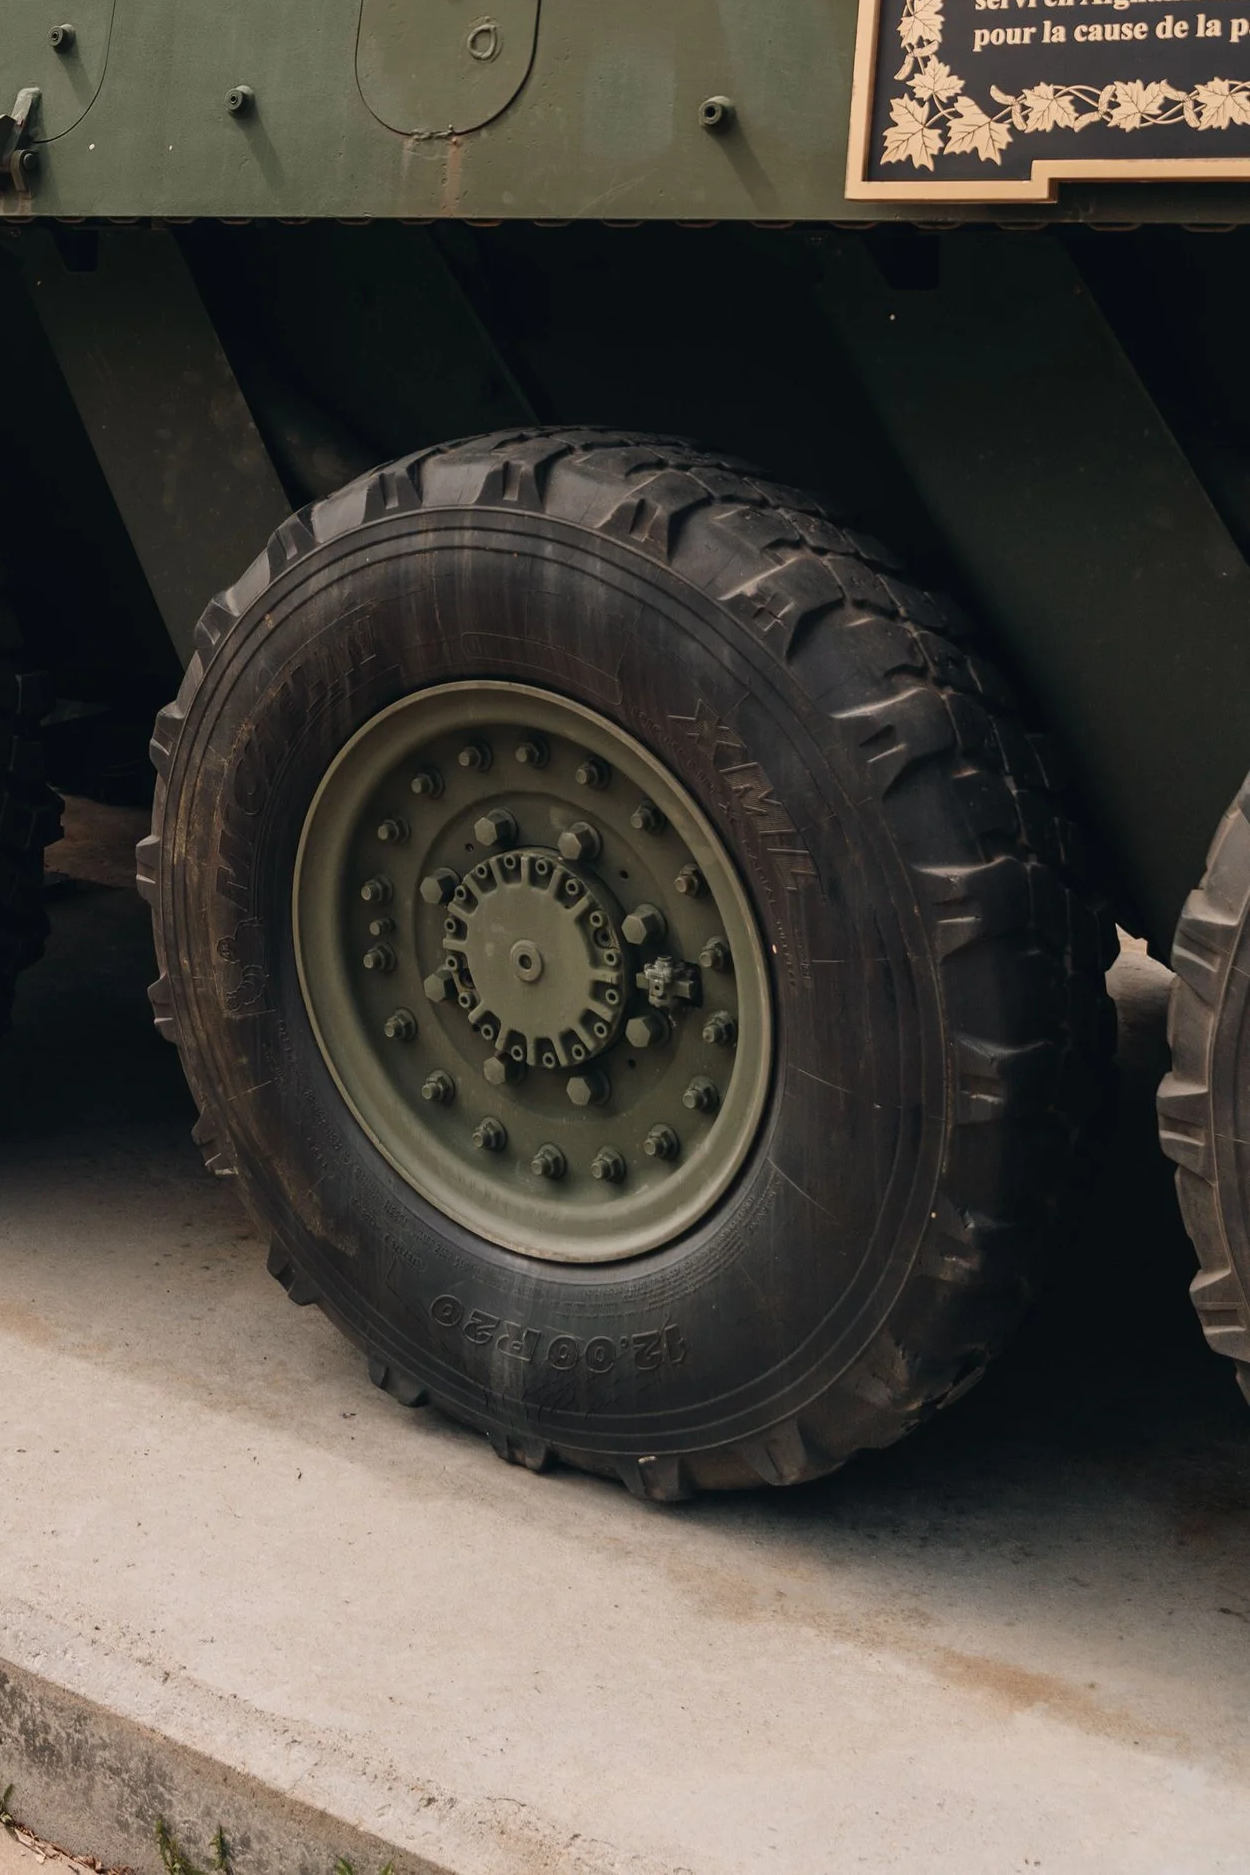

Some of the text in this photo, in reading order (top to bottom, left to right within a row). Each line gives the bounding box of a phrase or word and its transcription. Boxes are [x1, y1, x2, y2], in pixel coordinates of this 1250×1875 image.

[971, 26, 1037, 52] pour
[1041, 20, 1067, 44] la
[1073, 21, 1149, 42] cause
[1155, 14, 1189, 39] de
[1195, 13, 1222, 38] la
